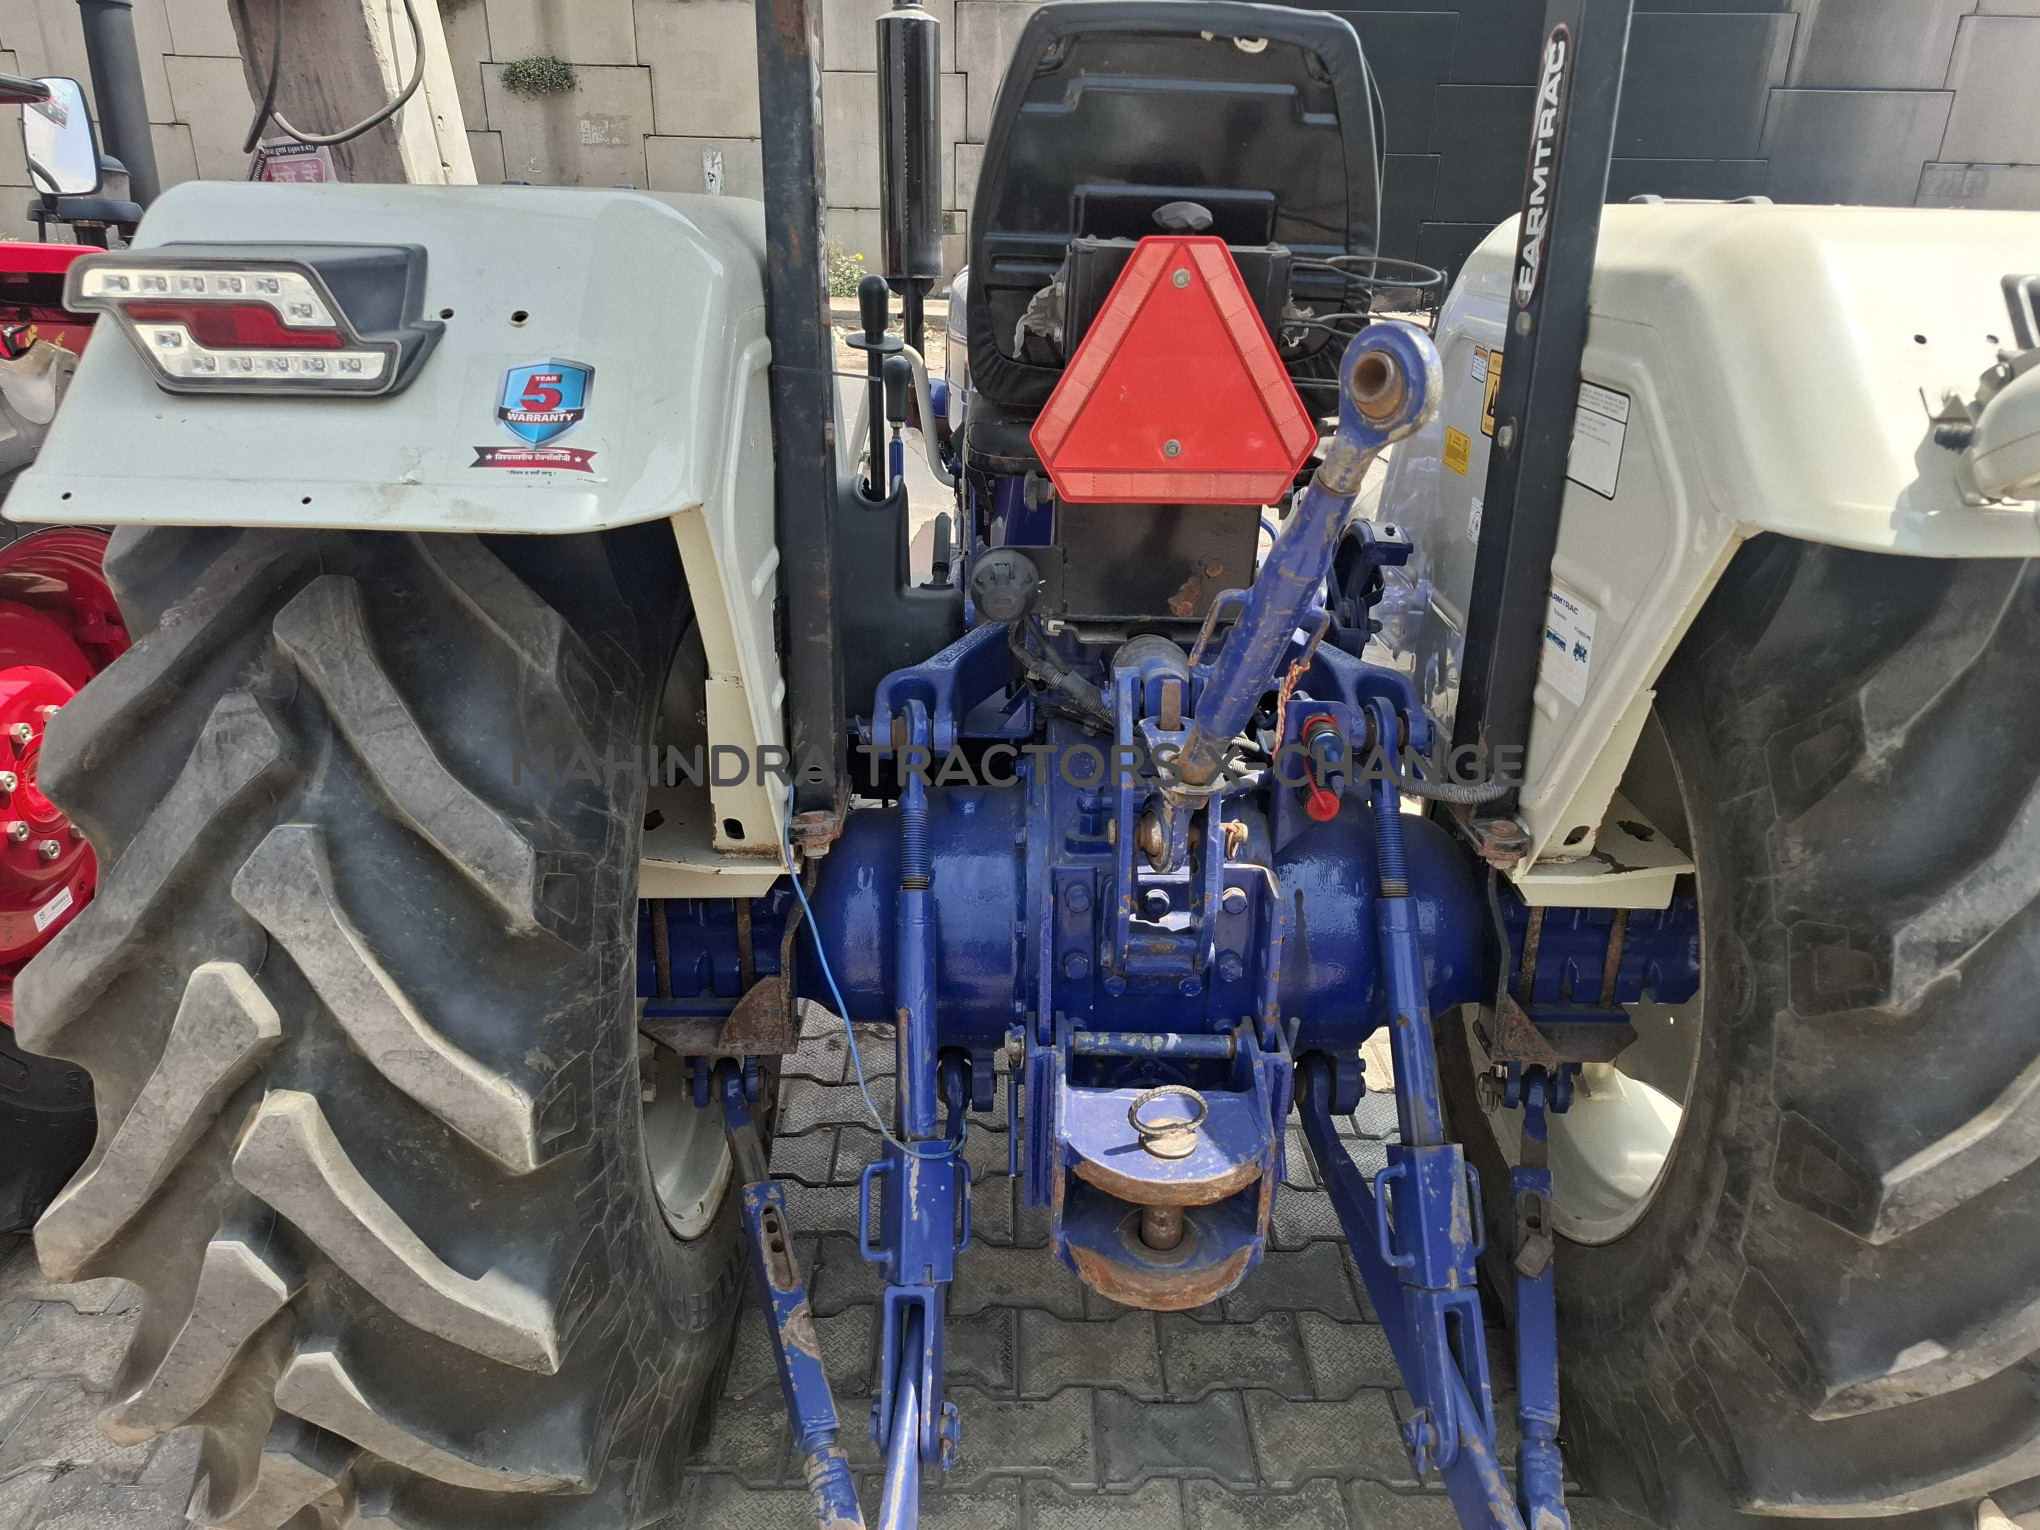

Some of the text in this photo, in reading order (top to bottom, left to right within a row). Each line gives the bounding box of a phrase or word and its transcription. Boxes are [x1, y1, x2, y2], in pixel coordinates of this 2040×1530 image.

[1517, 40, 1566, 292] FARMTRAC
[520, 374, 564, 413] 5
[507, 412, 574, 422] WARRANTY
[1547, 590, 1579, 616] ARMTRAC
